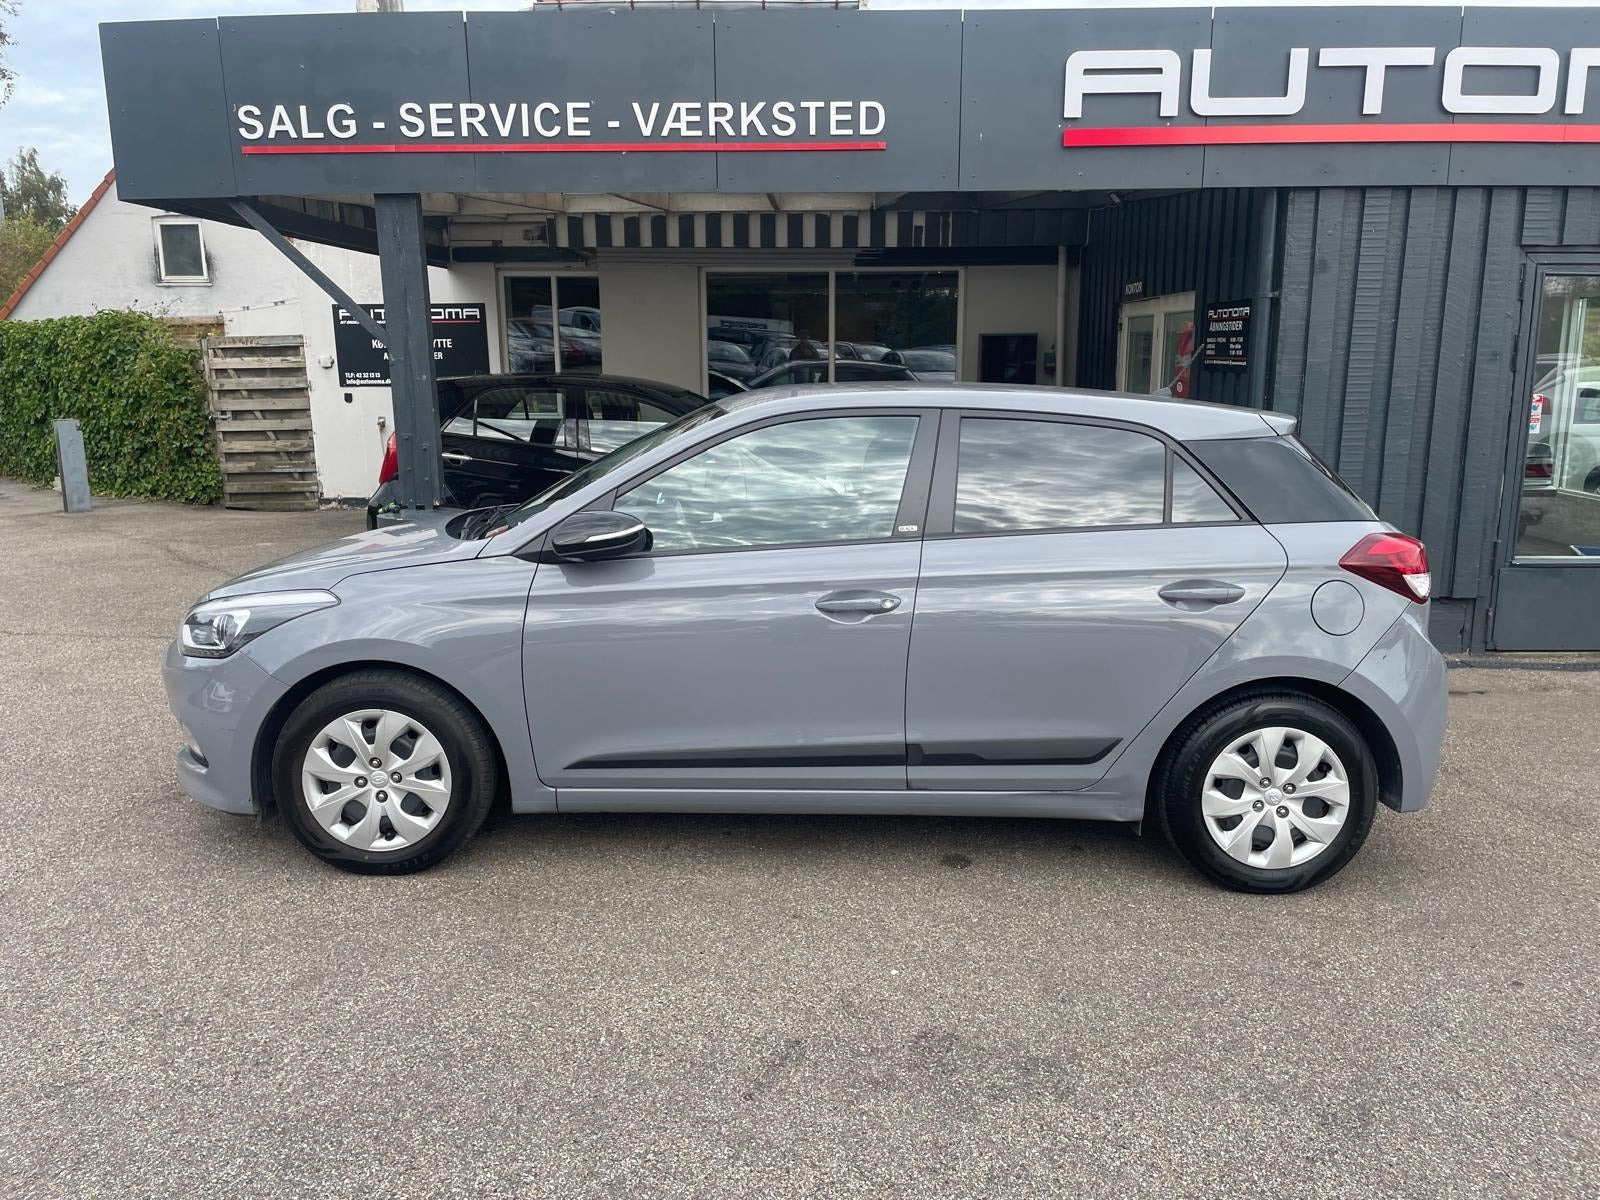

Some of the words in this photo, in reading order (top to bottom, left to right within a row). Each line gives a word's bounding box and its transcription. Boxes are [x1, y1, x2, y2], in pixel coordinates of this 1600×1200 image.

[236, 103, 357, 140] SALG
[399, 101, 593, 138] SERVICE
[631, 100, 887, 138] VÆRKSTED
[1207, 306, 1250, 319] AUTONOMA
